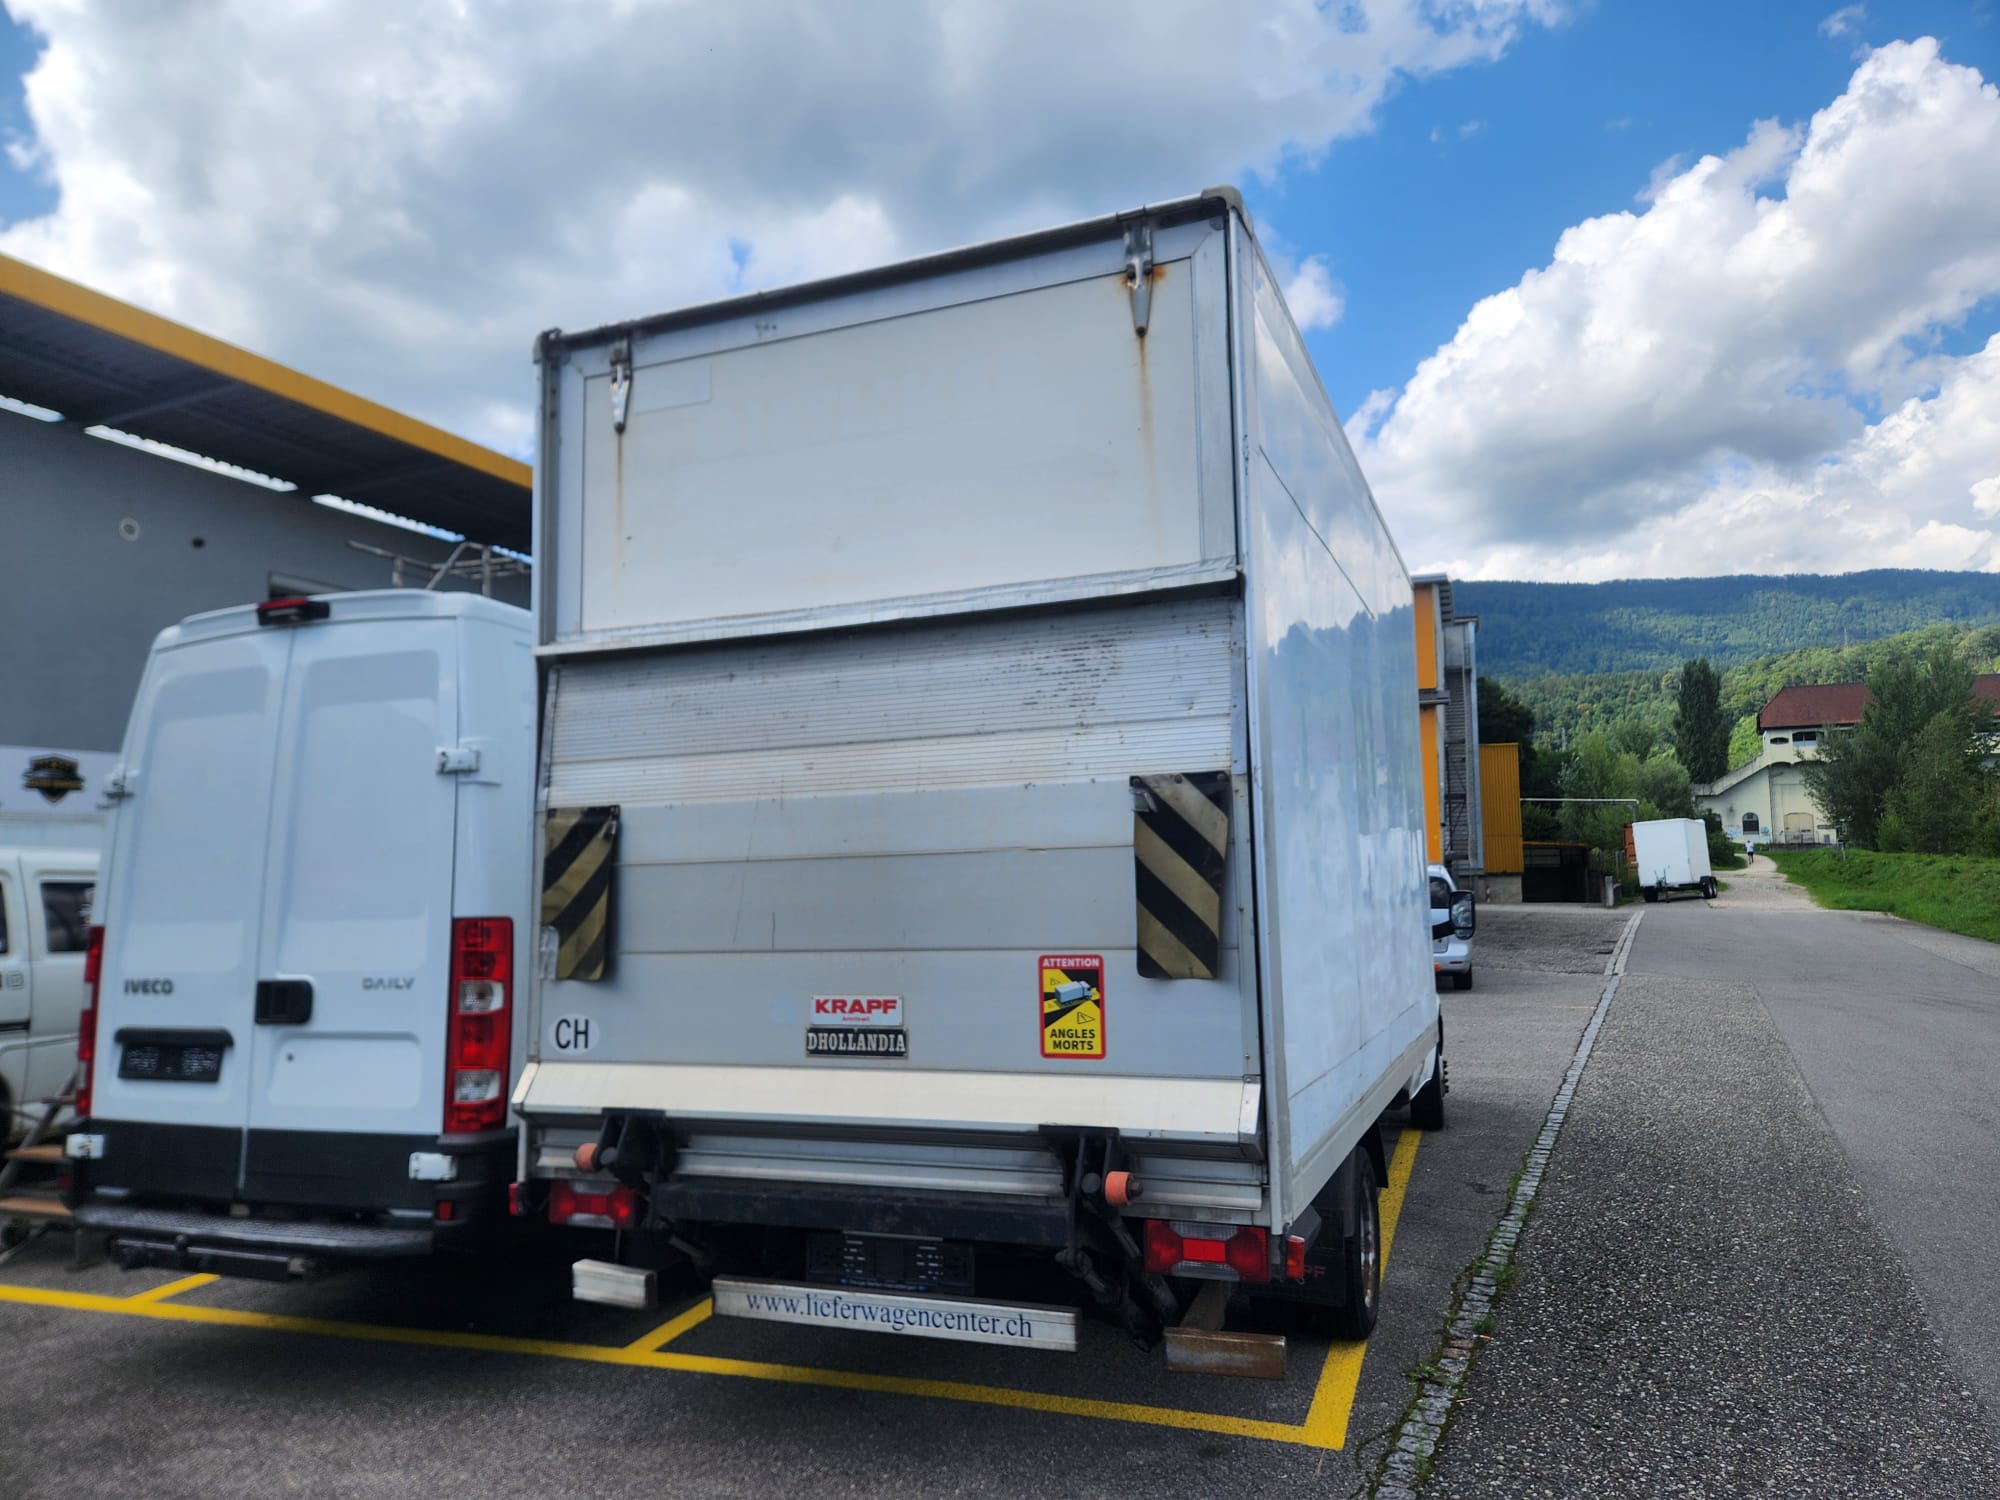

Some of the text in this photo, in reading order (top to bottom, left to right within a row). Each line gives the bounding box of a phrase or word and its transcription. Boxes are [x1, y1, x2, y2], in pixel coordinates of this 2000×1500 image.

[1042, 958, 1100, 968] ATTENTION
[124, 979, 174, 994] IVECO
[362, 977, 416, 991] DAILY
[815, 998, 898, 1015] KRAPF
[555, 1018, 589, 1050] CH
[1050, 1028, 1096, 1039] ANGLES
[807, 1032, 906, 1052] DHOLLANDIA
[1053, 1040, 1094, 1050] MORTS
[746, 1292, 1033, 1339] www.lieferwagencenter.ch
